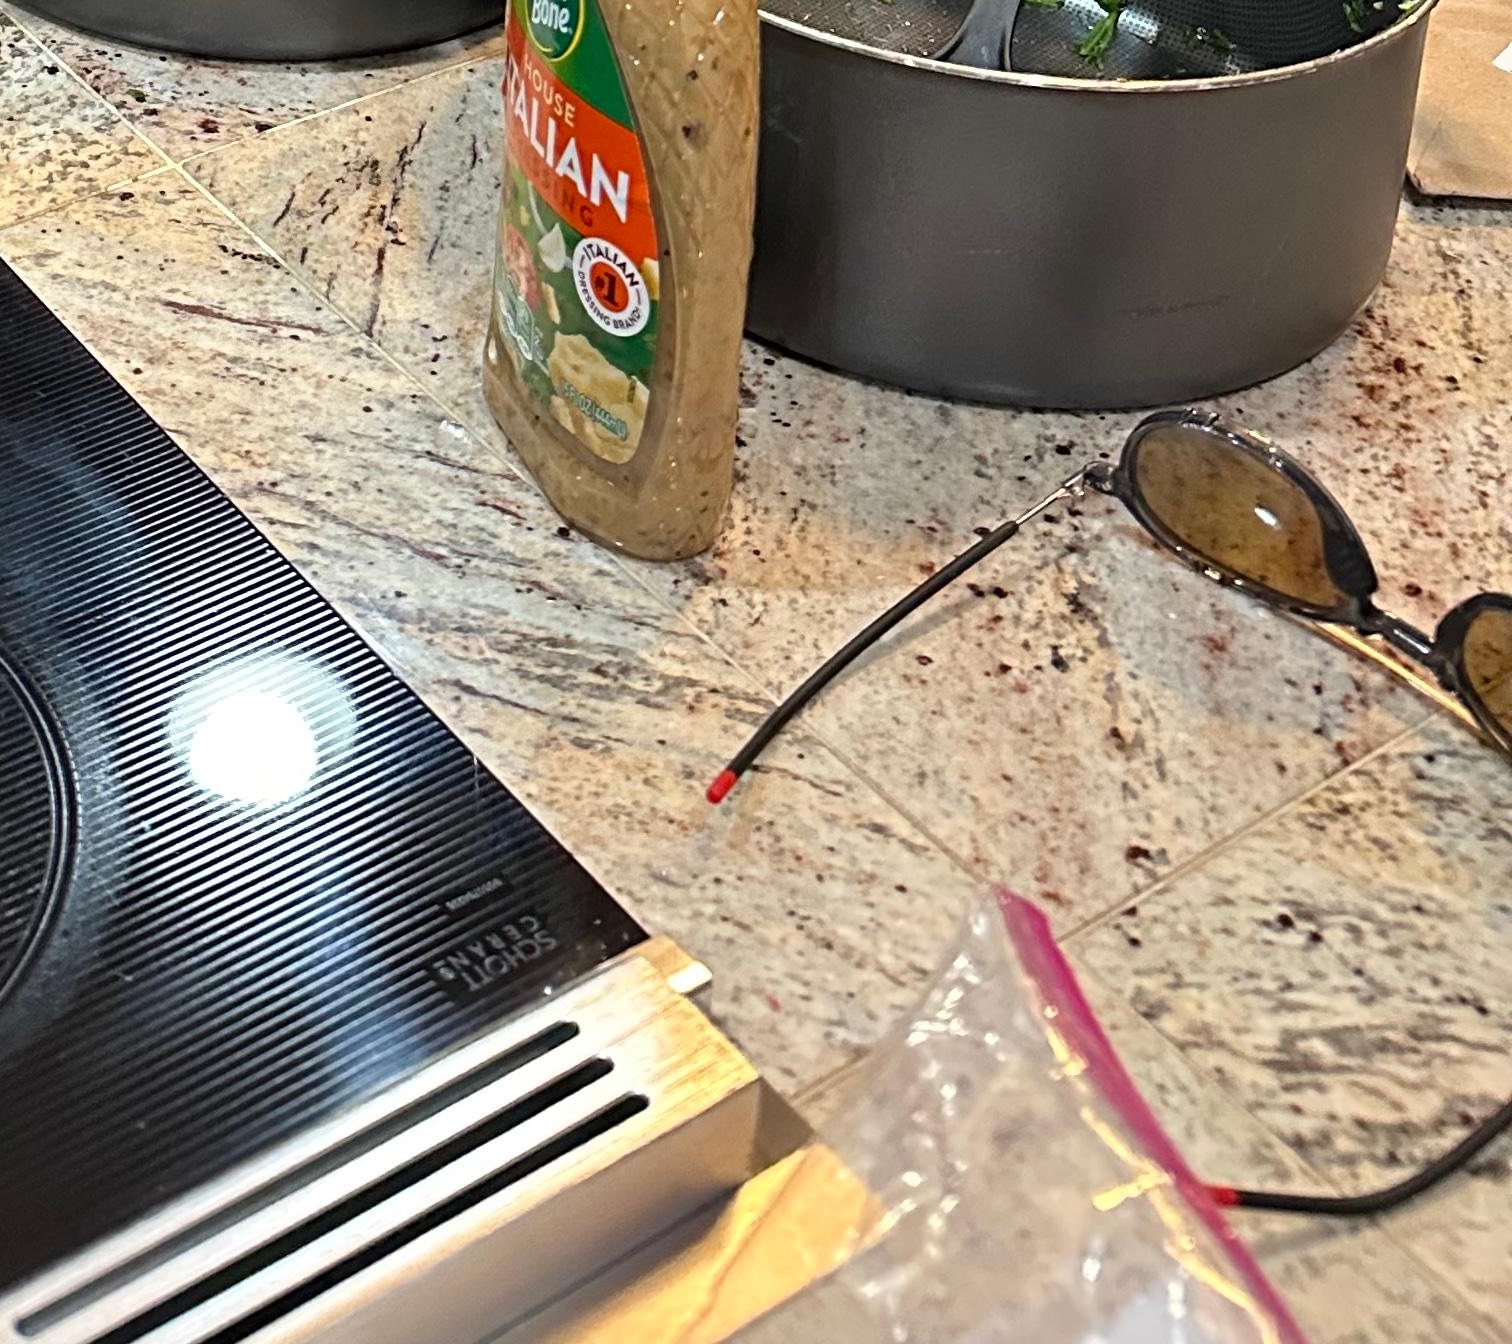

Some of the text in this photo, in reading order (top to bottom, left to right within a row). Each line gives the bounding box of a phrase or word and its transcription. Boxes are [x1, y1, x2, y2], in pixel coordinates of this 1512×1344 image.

[523, 52, 576, 128] HOUSE
[506, 52, 630, 224] ITALIAN
[582, 242, 640, 288] ITALIAN
[594, 270, 621, 308] #1
[577, 270, 611, 327] DRESSING
[444, 914, 539, 969] CERAN
[458, 930, 558, 993] SCHOTT
